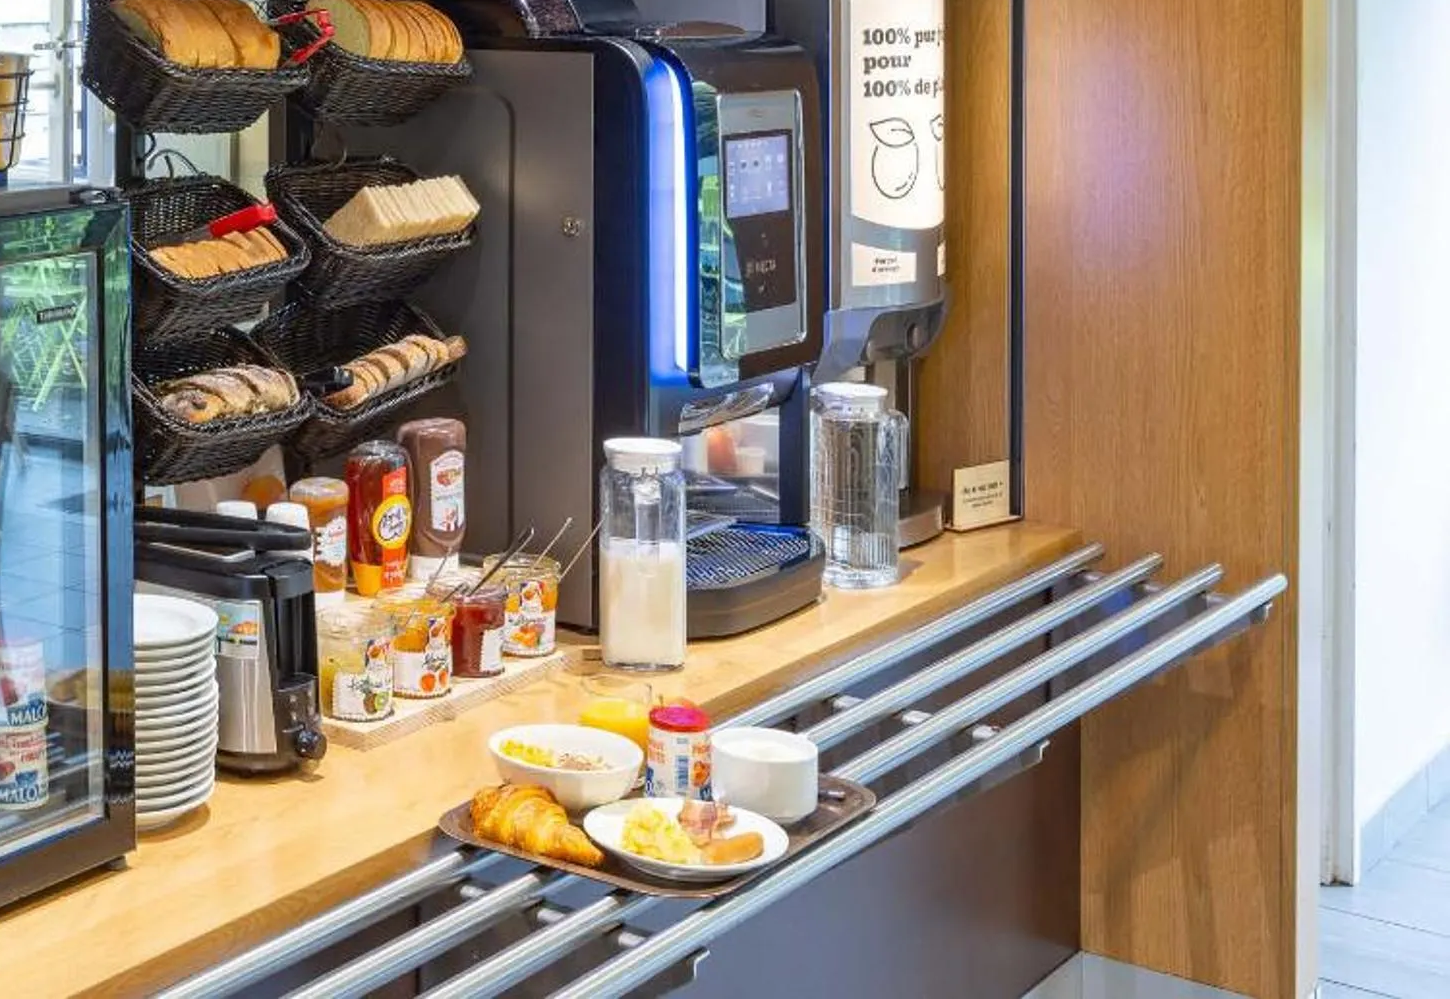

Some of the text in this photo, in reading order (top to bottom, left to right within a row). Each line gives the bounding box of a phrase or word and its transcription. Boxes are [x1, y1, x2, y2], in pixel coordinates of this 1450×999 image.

[863, 26, 912, 46] 100%
[863, 55, 912, 76] pour
[863, 79, 911, 98] 100%
[914, 78, 931, 96] de
